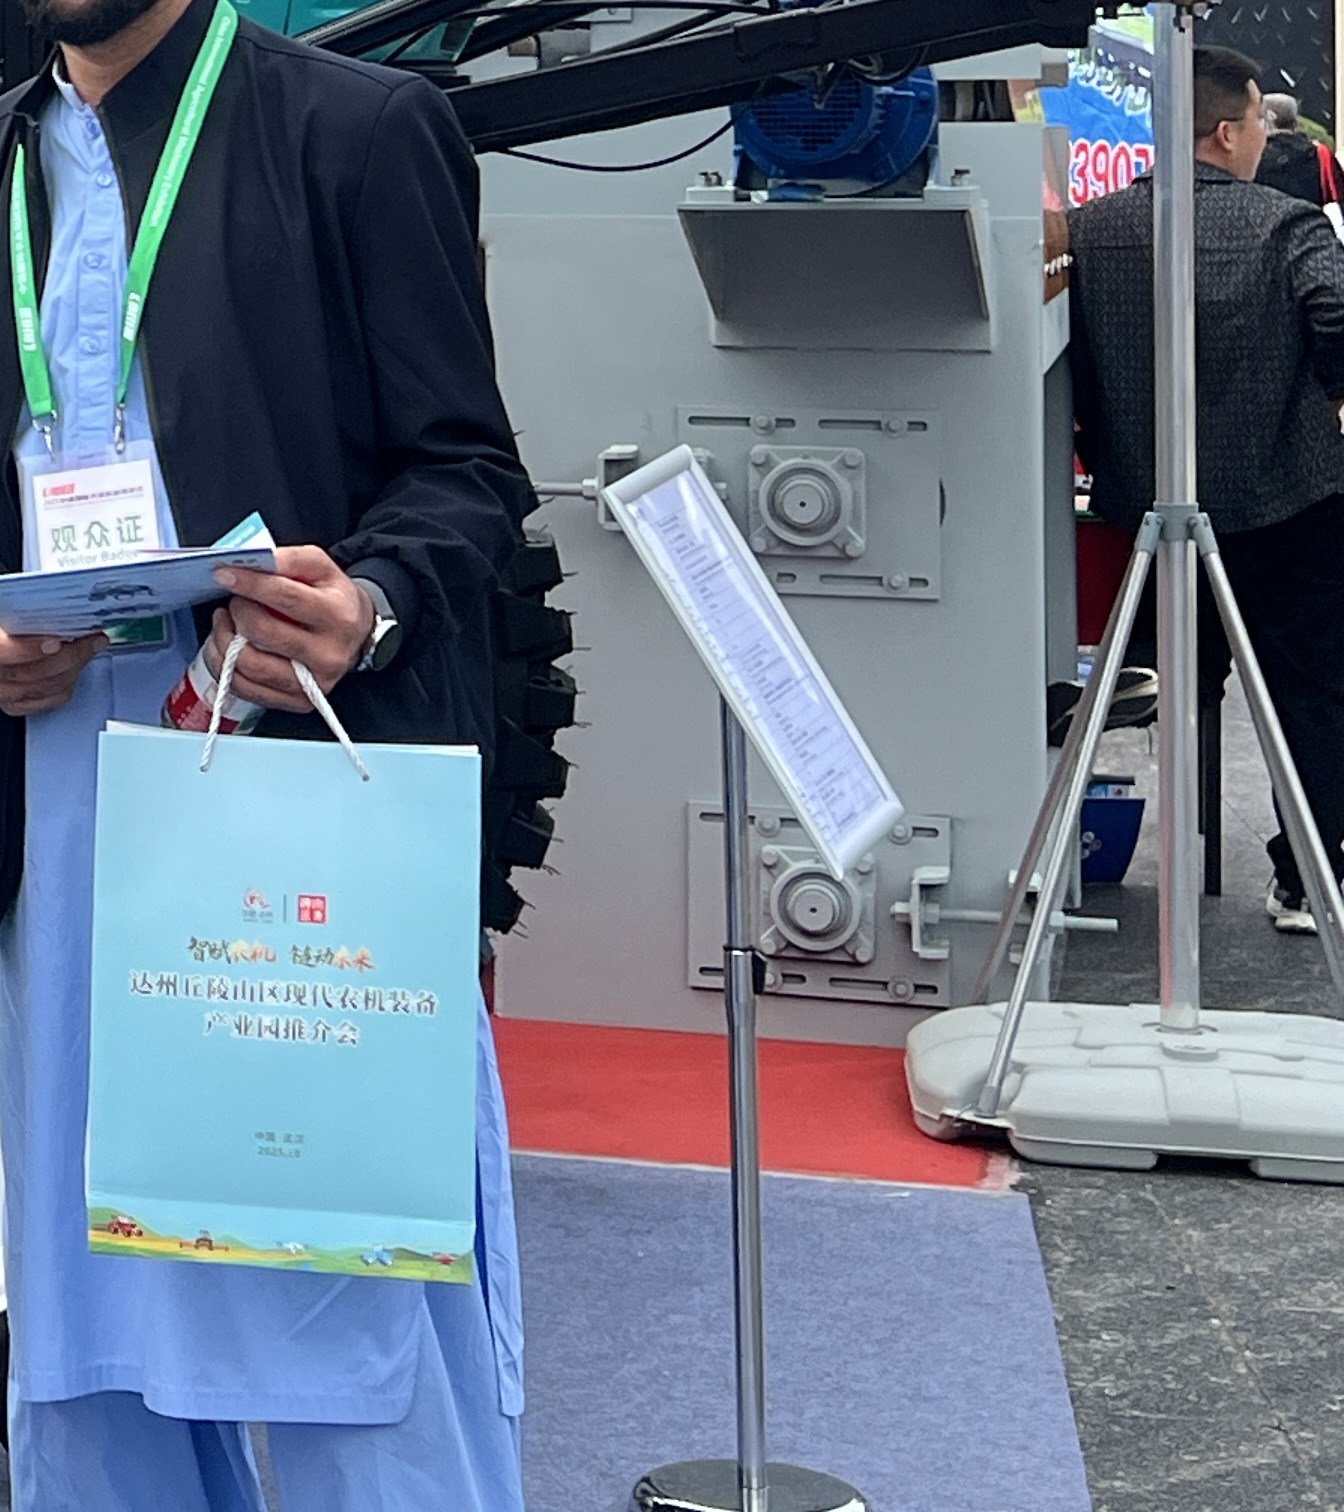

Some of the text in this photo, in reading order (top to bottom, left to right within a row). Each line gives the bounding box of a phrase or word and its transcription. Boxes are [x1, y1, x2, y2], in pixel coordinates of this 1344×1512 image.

[50, 515, 146, 554] 观众证
[129, 969, 438, 1016] 达州丘陵山区现代农机装备
[204, 1011, 359, 1047] 产业园推介会
